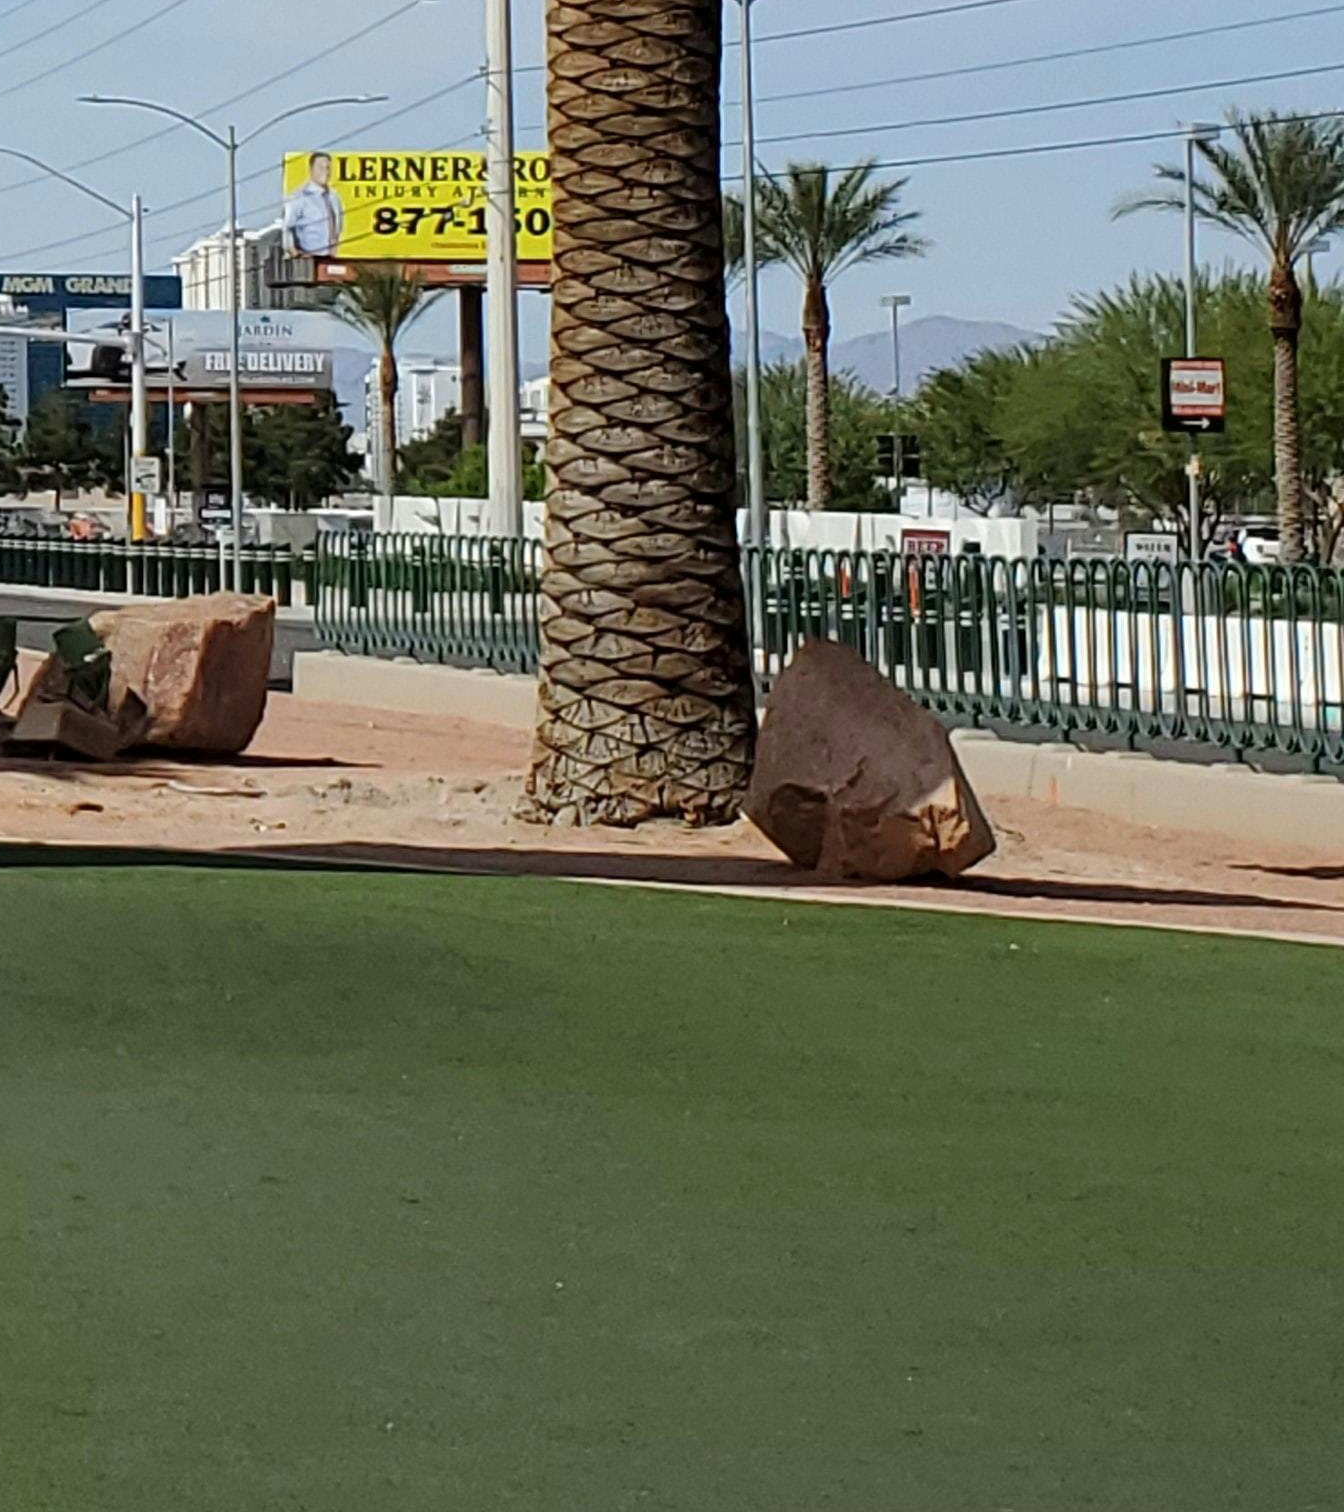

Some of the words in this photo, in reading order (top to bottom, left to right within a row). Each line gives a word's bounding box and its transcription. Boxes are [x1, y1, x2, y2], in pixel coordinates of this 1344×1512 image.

[512, 157, 551, 183] RO
[2, 276, 55, 294] MGM
[246, 351, 326, 373] DELIVERY
